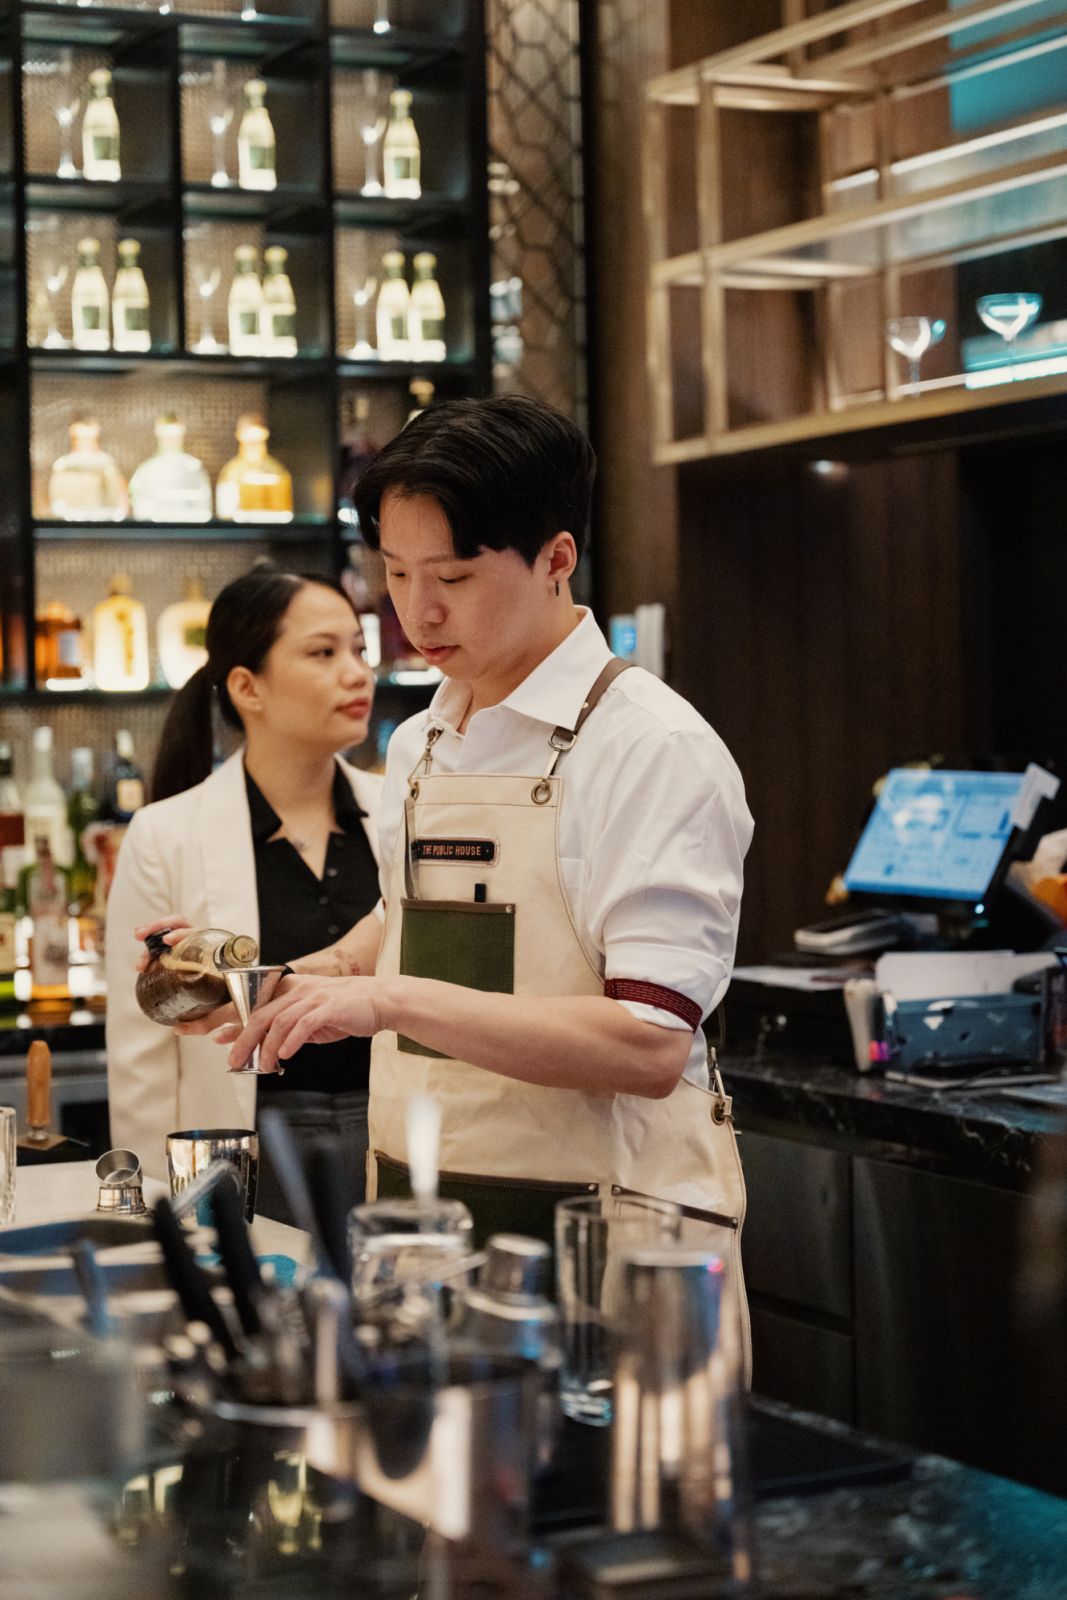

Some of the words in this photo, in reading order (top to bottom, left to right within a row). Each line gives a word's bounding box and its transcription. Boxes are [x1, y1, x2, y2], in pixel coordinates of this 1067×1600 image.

[423, 845, 432, 855] THE
[432, 845, 454, 856] PUBLIC
[456, 846, 481, 856] HOUSE
